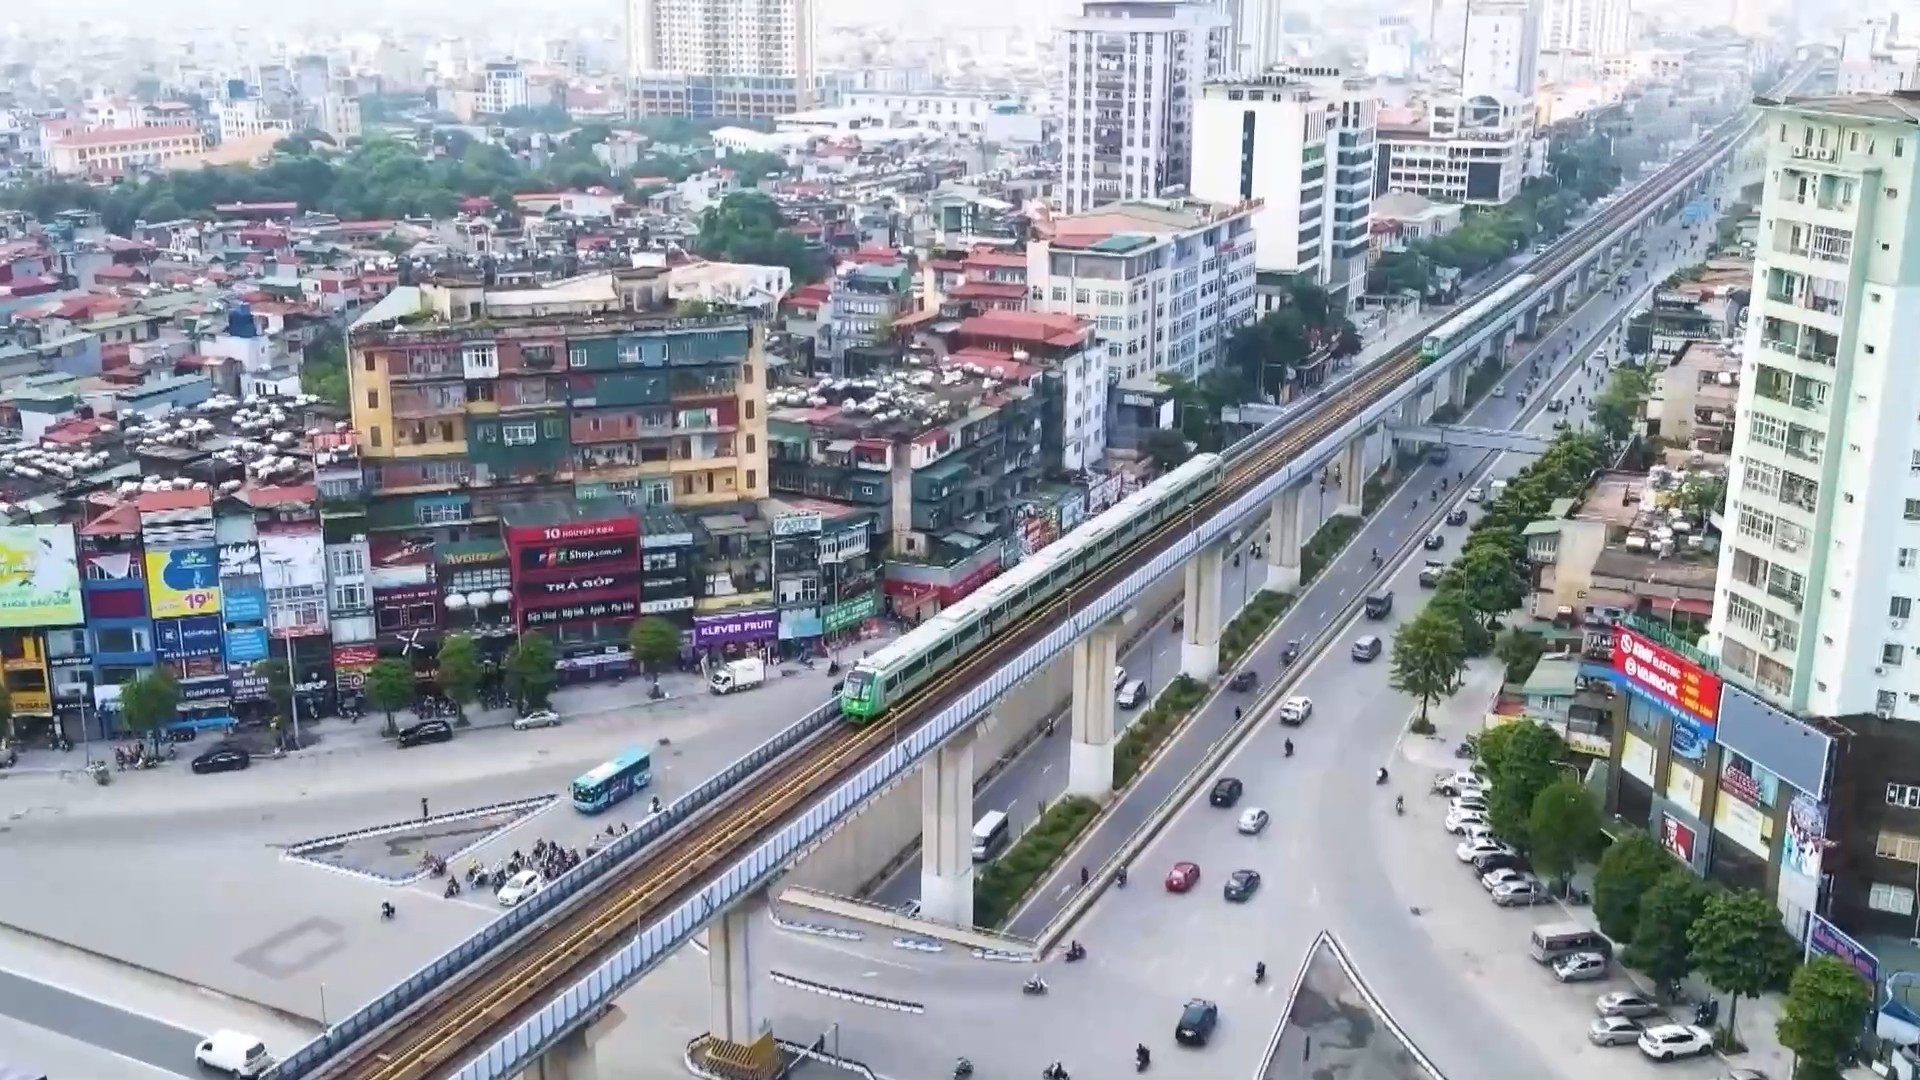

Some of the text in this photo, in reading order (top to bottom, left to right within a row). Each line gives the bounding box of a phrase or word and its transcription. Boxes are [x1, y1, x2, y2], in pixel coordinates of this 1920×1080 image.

[544, 527, 562, 540] 10
[545, 576, 579, 593] TRẢ
[701, 619, 774, 637] KLEVER FRUIT
